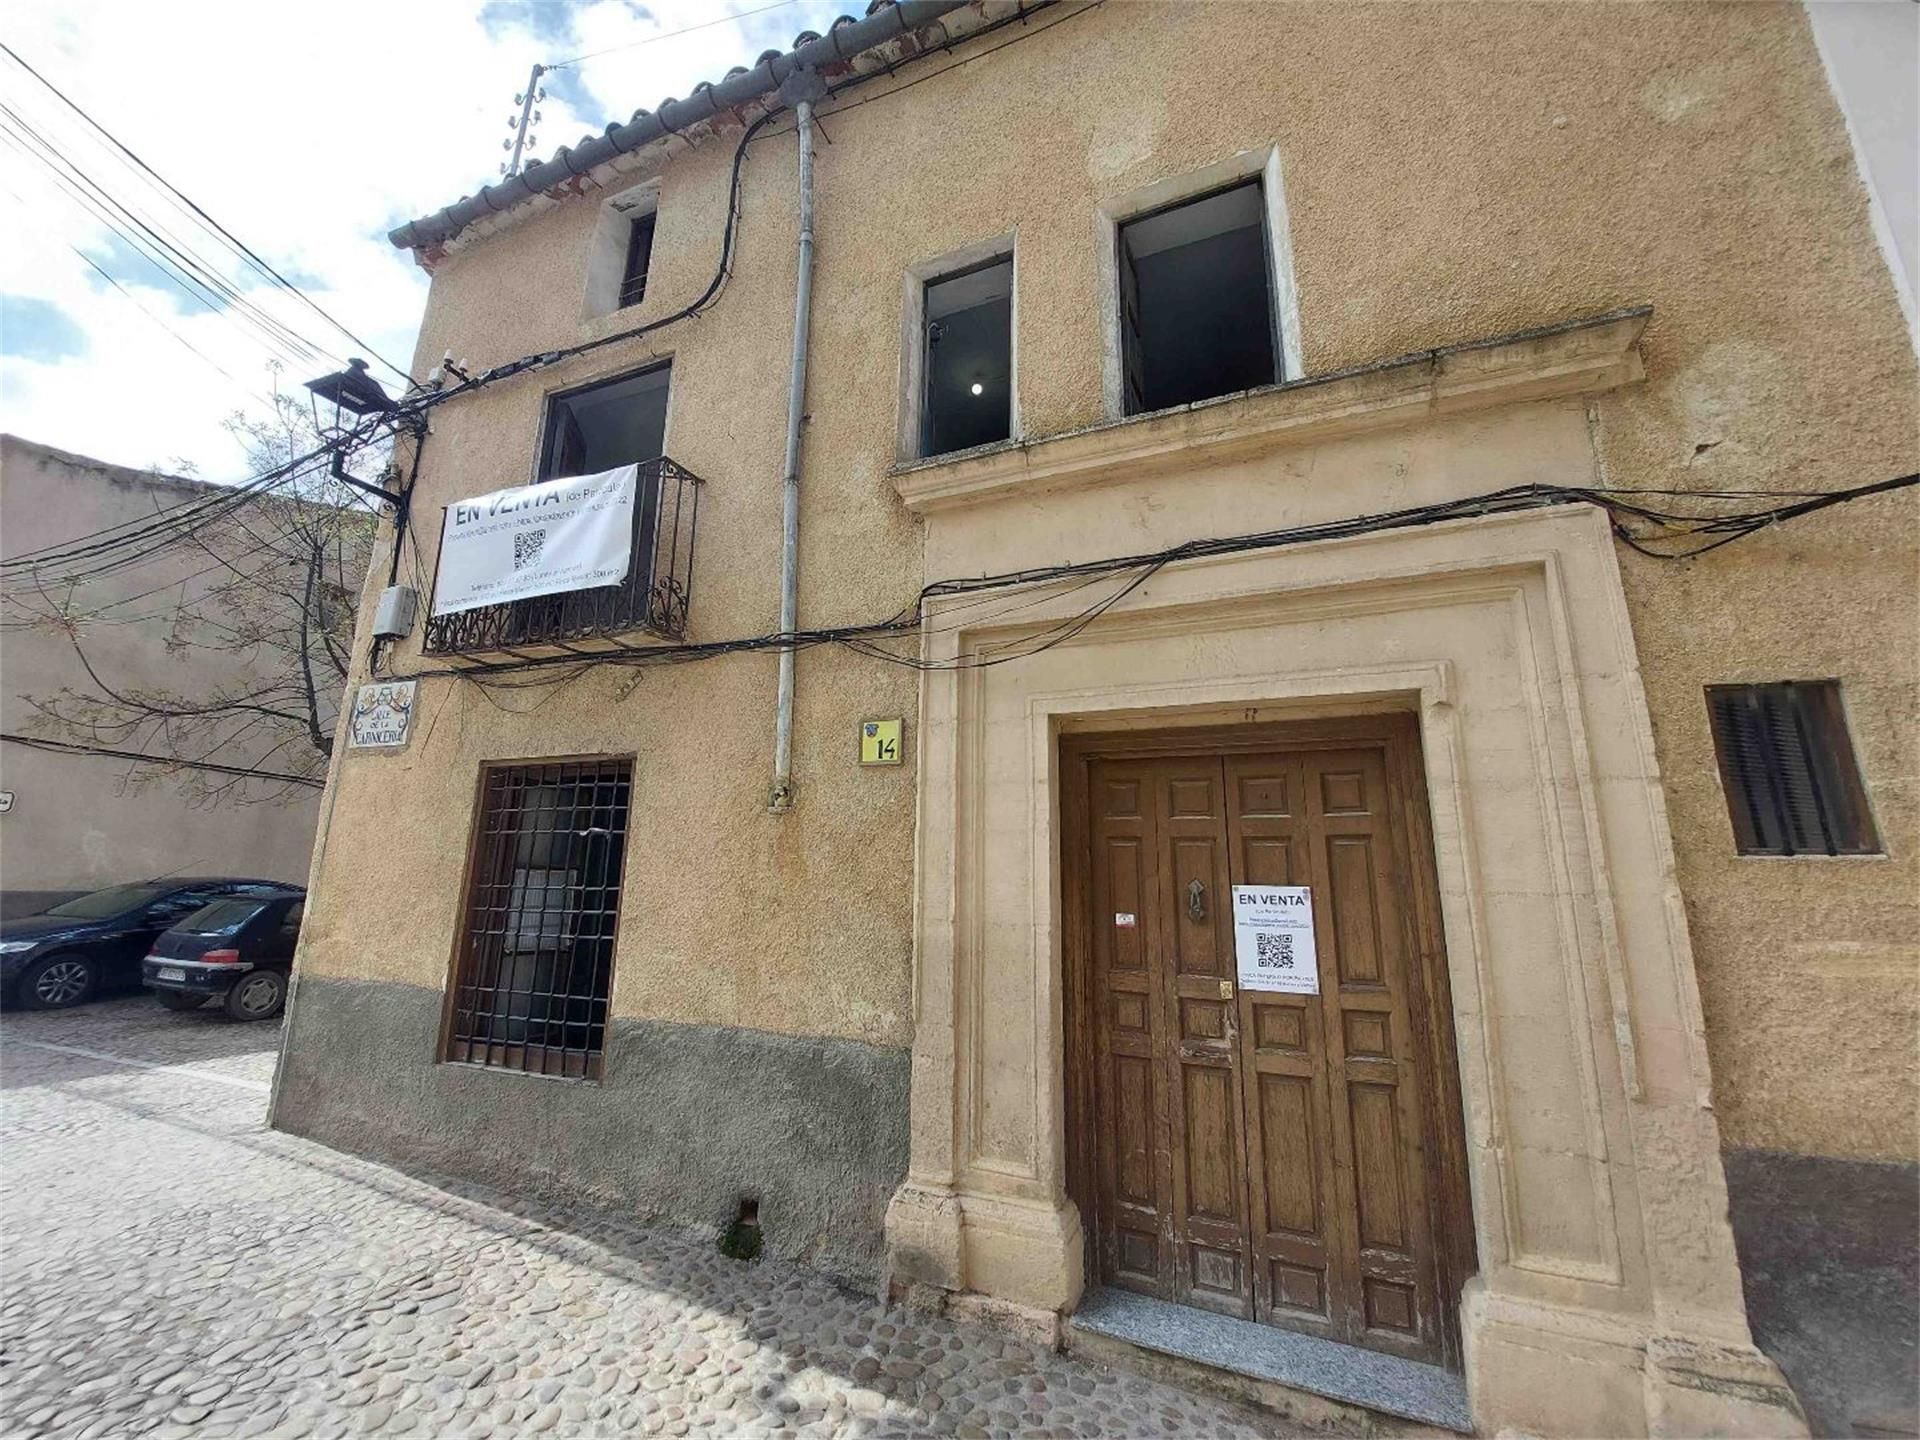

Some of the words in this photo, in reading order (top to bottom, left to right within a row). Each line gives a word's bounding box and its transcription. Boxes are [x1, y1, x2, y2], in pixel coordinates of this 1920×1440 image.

[455, 505, 480, 526] EN
[489, 490, 560, 517] VENTA
[877, 738, 896, 759] 14
[1239, 894, 1257, 905] EN
[1260, 894, 1305, 906] VENTA
